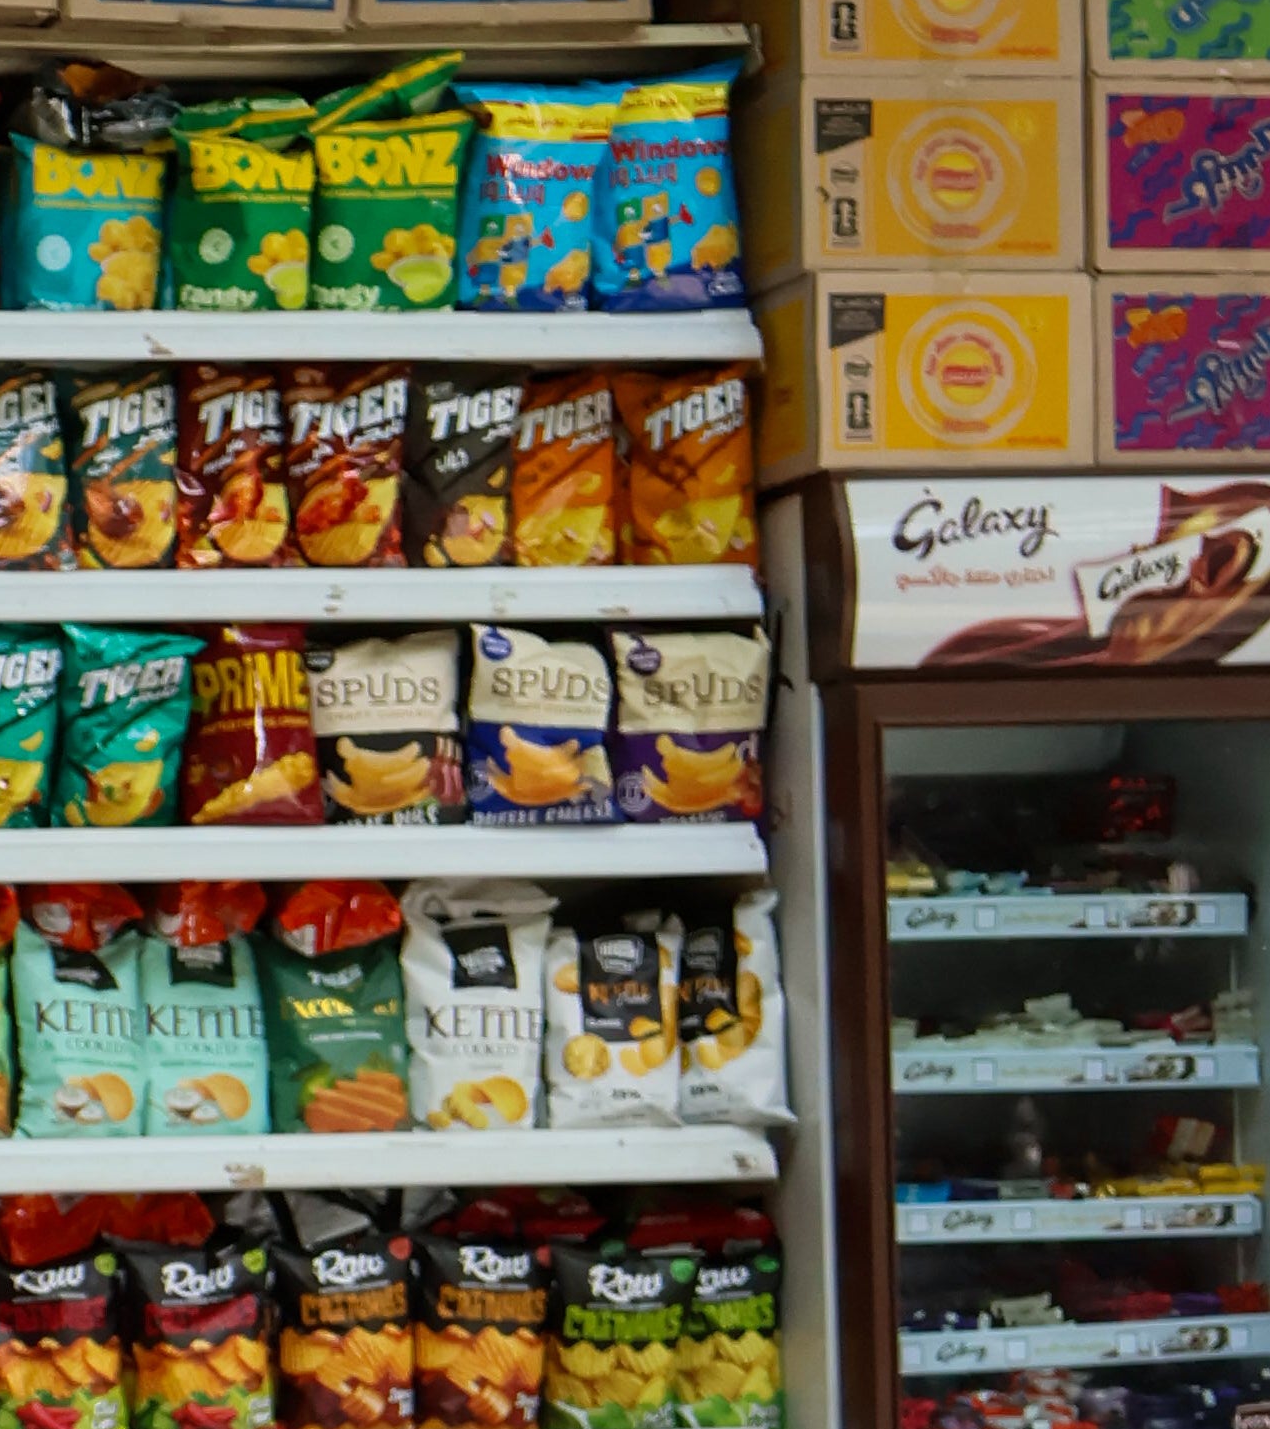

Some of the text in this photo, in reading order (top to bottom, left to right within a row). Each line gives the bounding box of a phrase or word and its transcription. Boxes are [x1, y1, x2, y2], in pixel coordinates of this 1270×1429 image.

[317, 130, 460, 186] BONZ
[891, 494, 1059, 560] Galaxy
[317, 672, 441, 710] SPUDS
[491, 665, 609, 704] SPUDS
[643, 671, 761, 709] SPUDS
[161, 1261, 235, 1296] Raw
